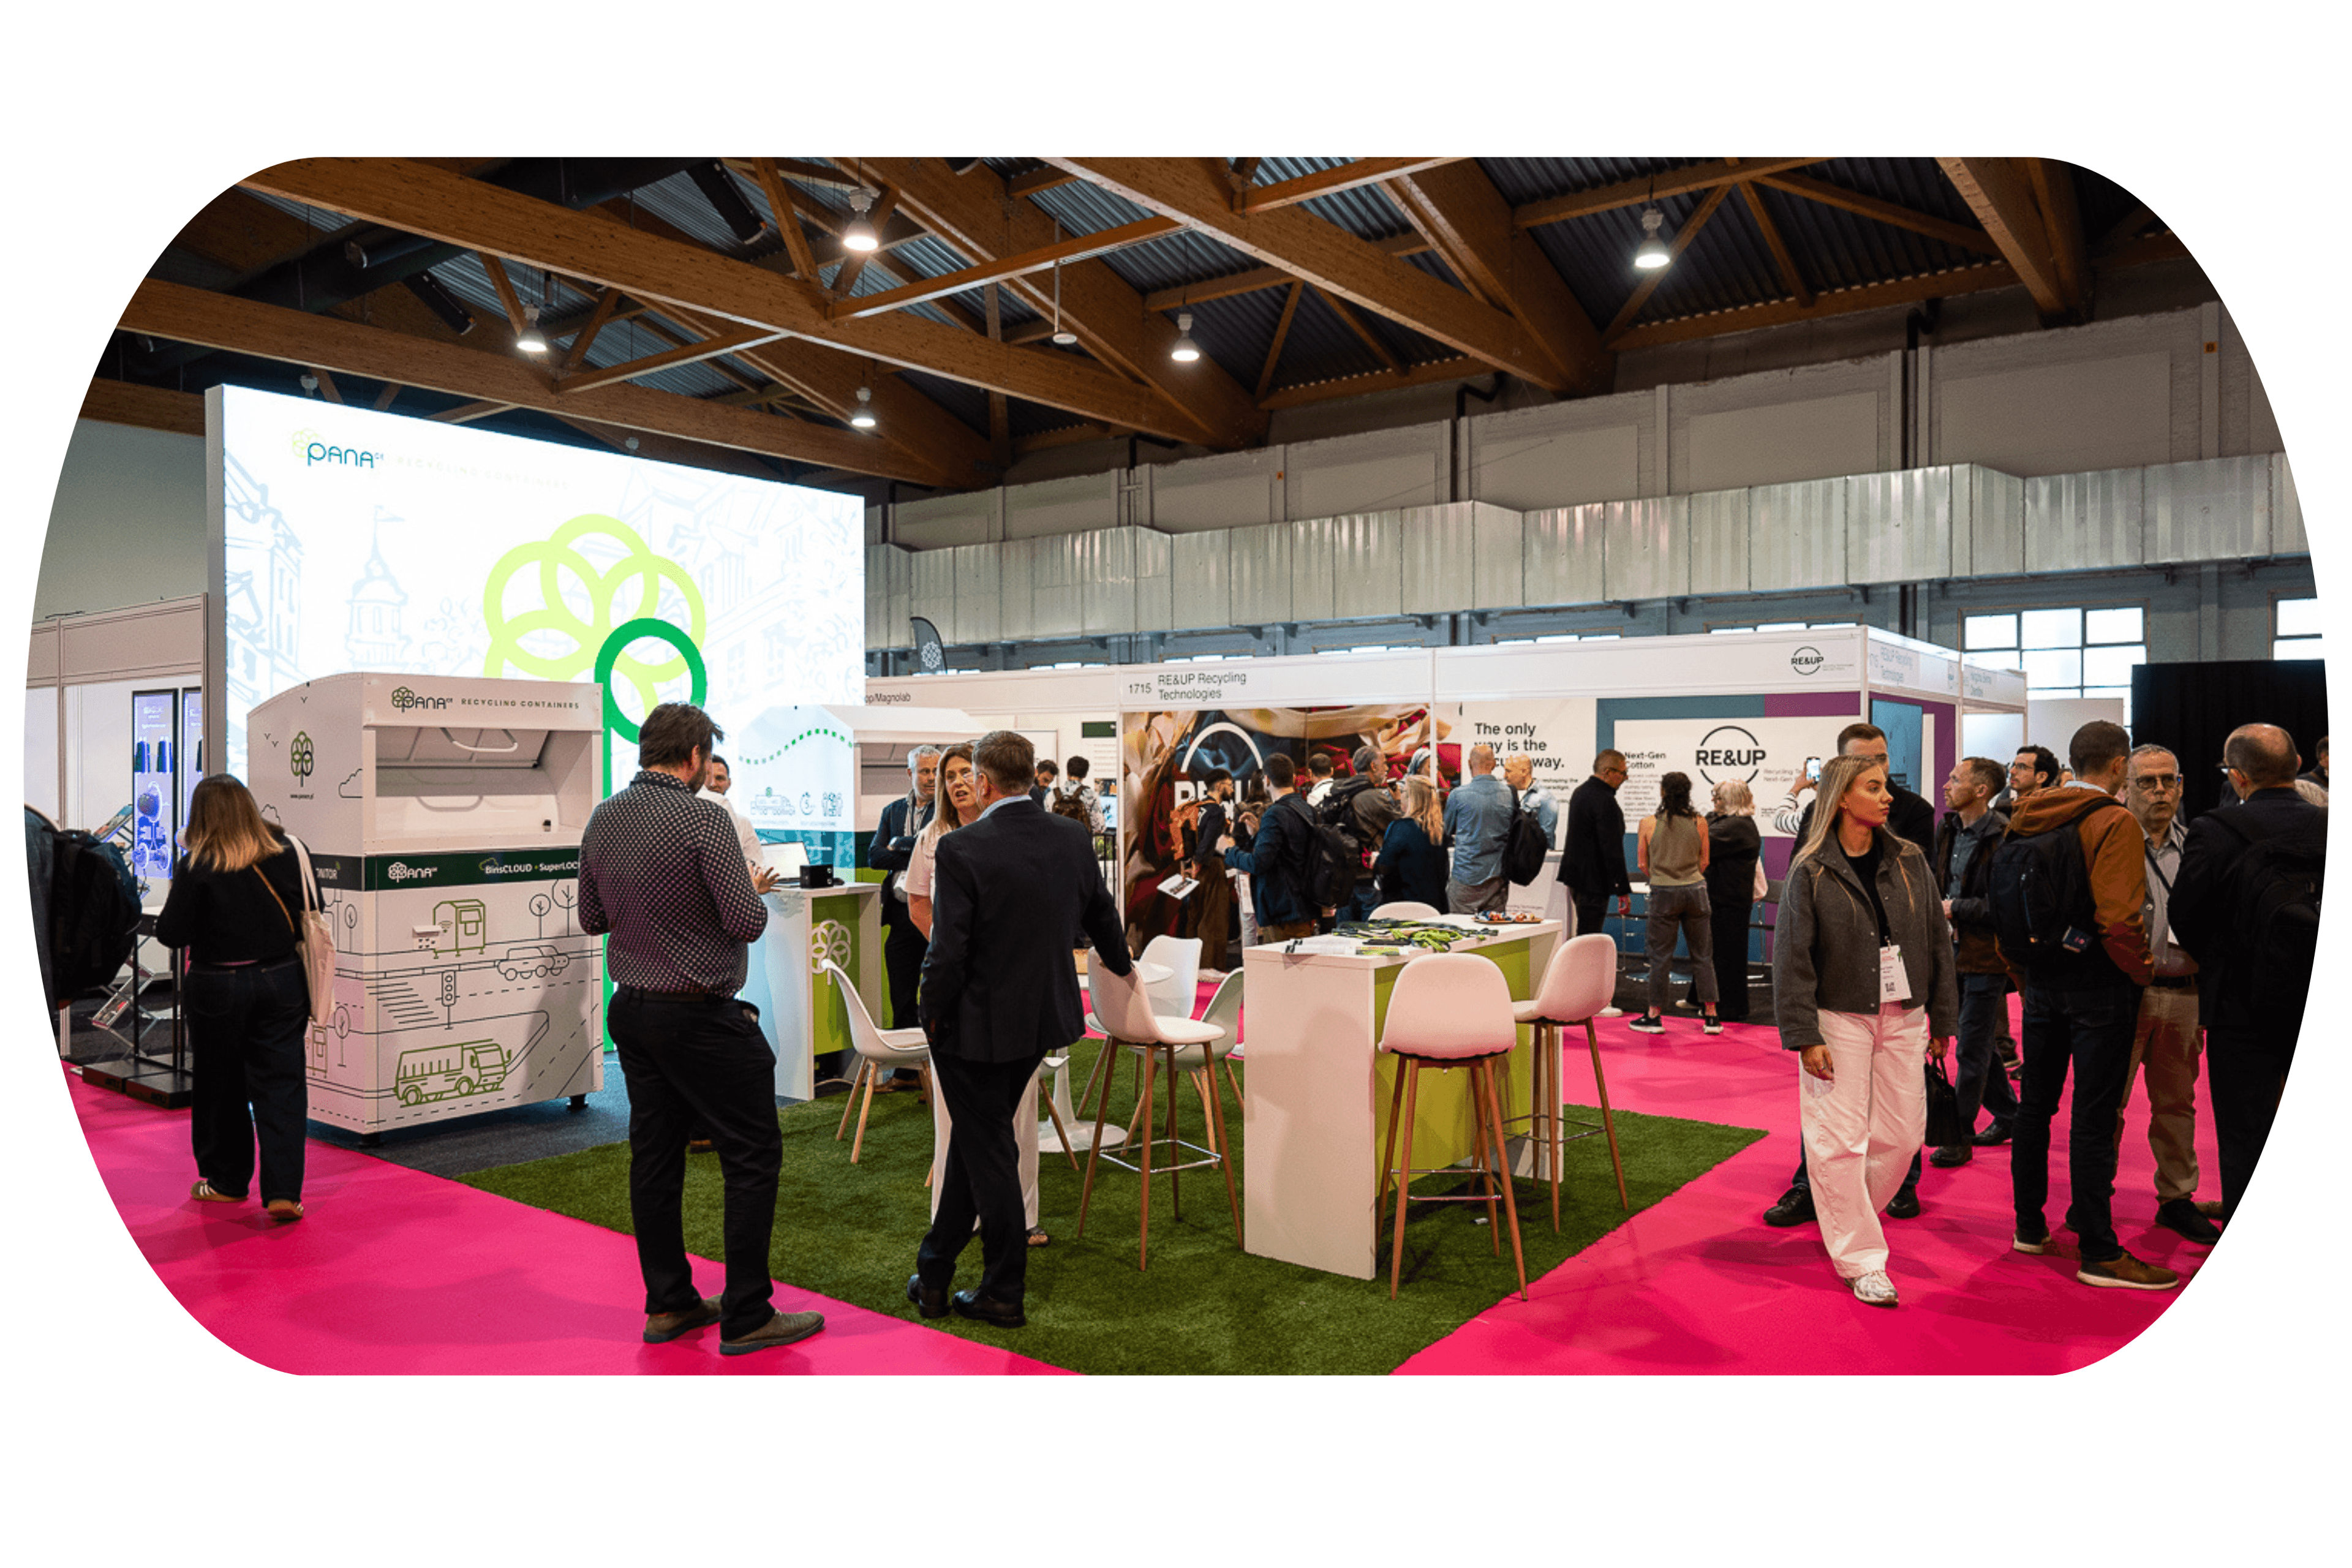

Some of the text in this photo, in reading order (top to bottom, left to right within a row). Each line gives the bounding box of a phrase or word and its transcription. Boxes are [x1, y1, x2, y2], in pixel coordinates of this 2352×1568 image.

[1791, 656, 1824, 665] RE&UP
[1158, 672, 1246, 685] RE&UP Recycling
[1129, 683, 1152, 694] 1715
[1158, 688, 1222, 701] Technologies
[461, 698, 516, 707] RECYCLING
[520, 700, 579, 709] CONTAINERS
[1474, 722, 1536, 737] The only
[1507, 739, 1519, 751] is
[1523, 739, 1547, 751] the
[1532, 758, 1566, 771] way.
[1695, 750, 1766, 766] RE&UP
